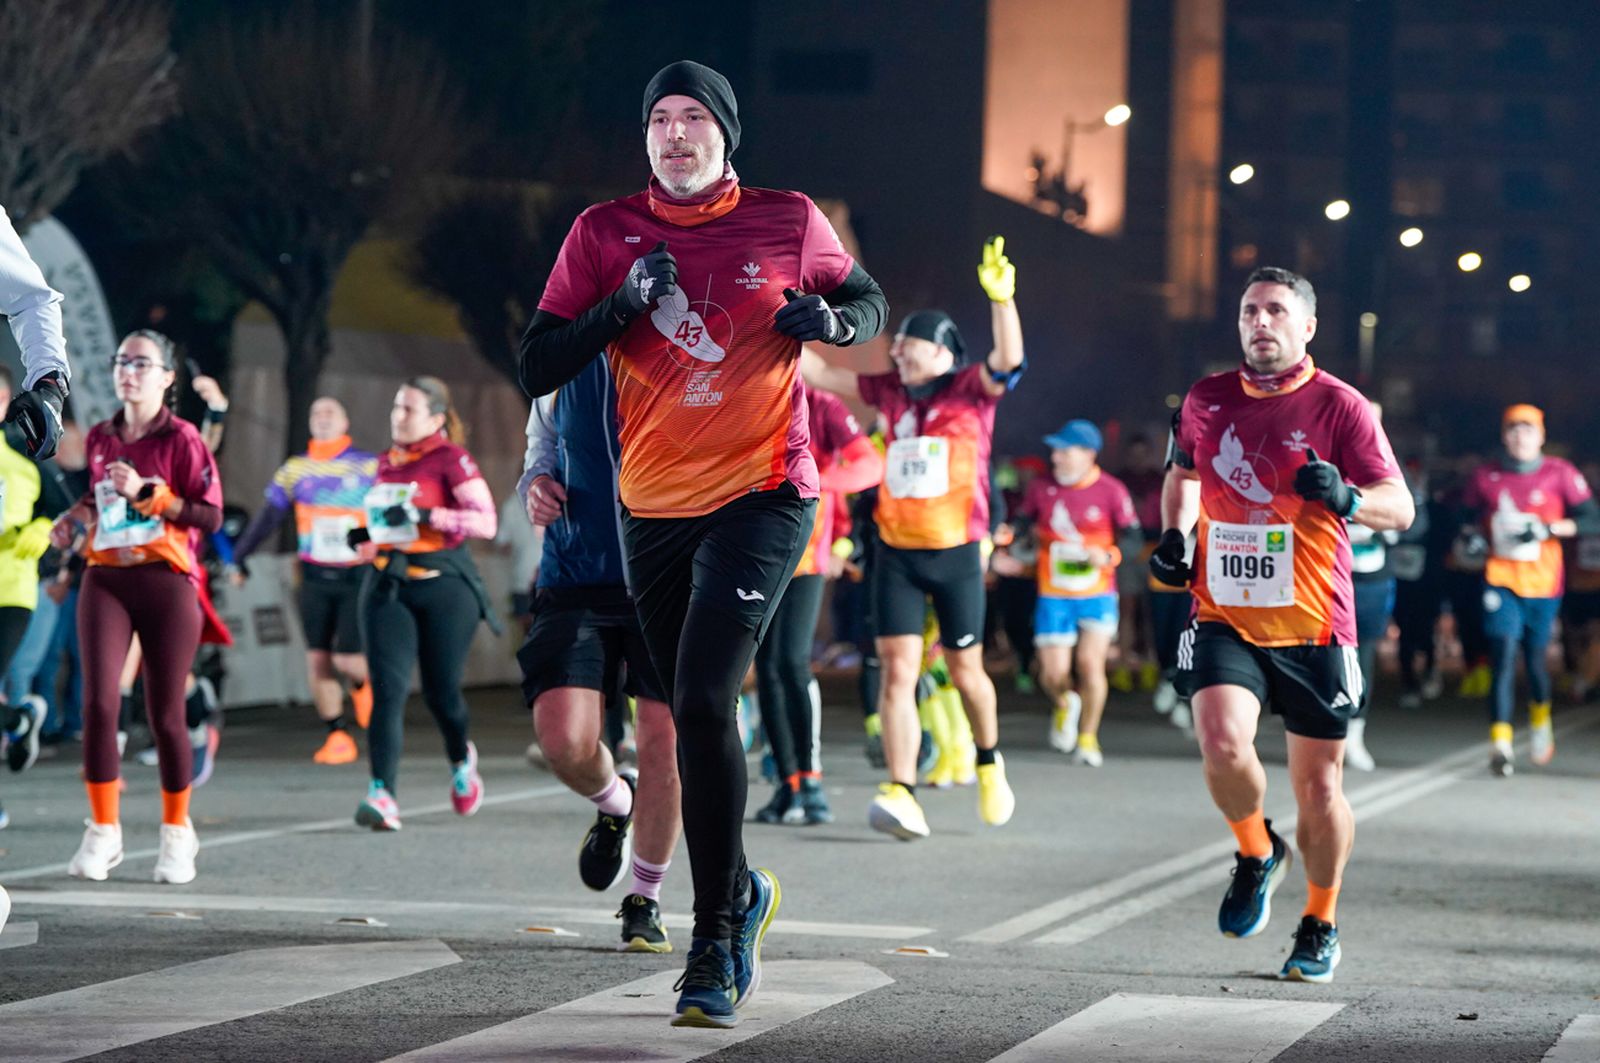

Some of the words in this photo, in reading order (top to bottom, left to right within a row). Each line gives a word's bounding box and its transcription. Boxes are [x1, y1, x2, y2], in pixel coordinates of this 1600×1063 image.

[674, 320, 703, 348] 43
[685, 382, 710, 393] SAN
[1229, 466, 1252, 490] 43
[1247, 535, 1258, 543] DE
[1220, 554, 1275, 579] 1096
